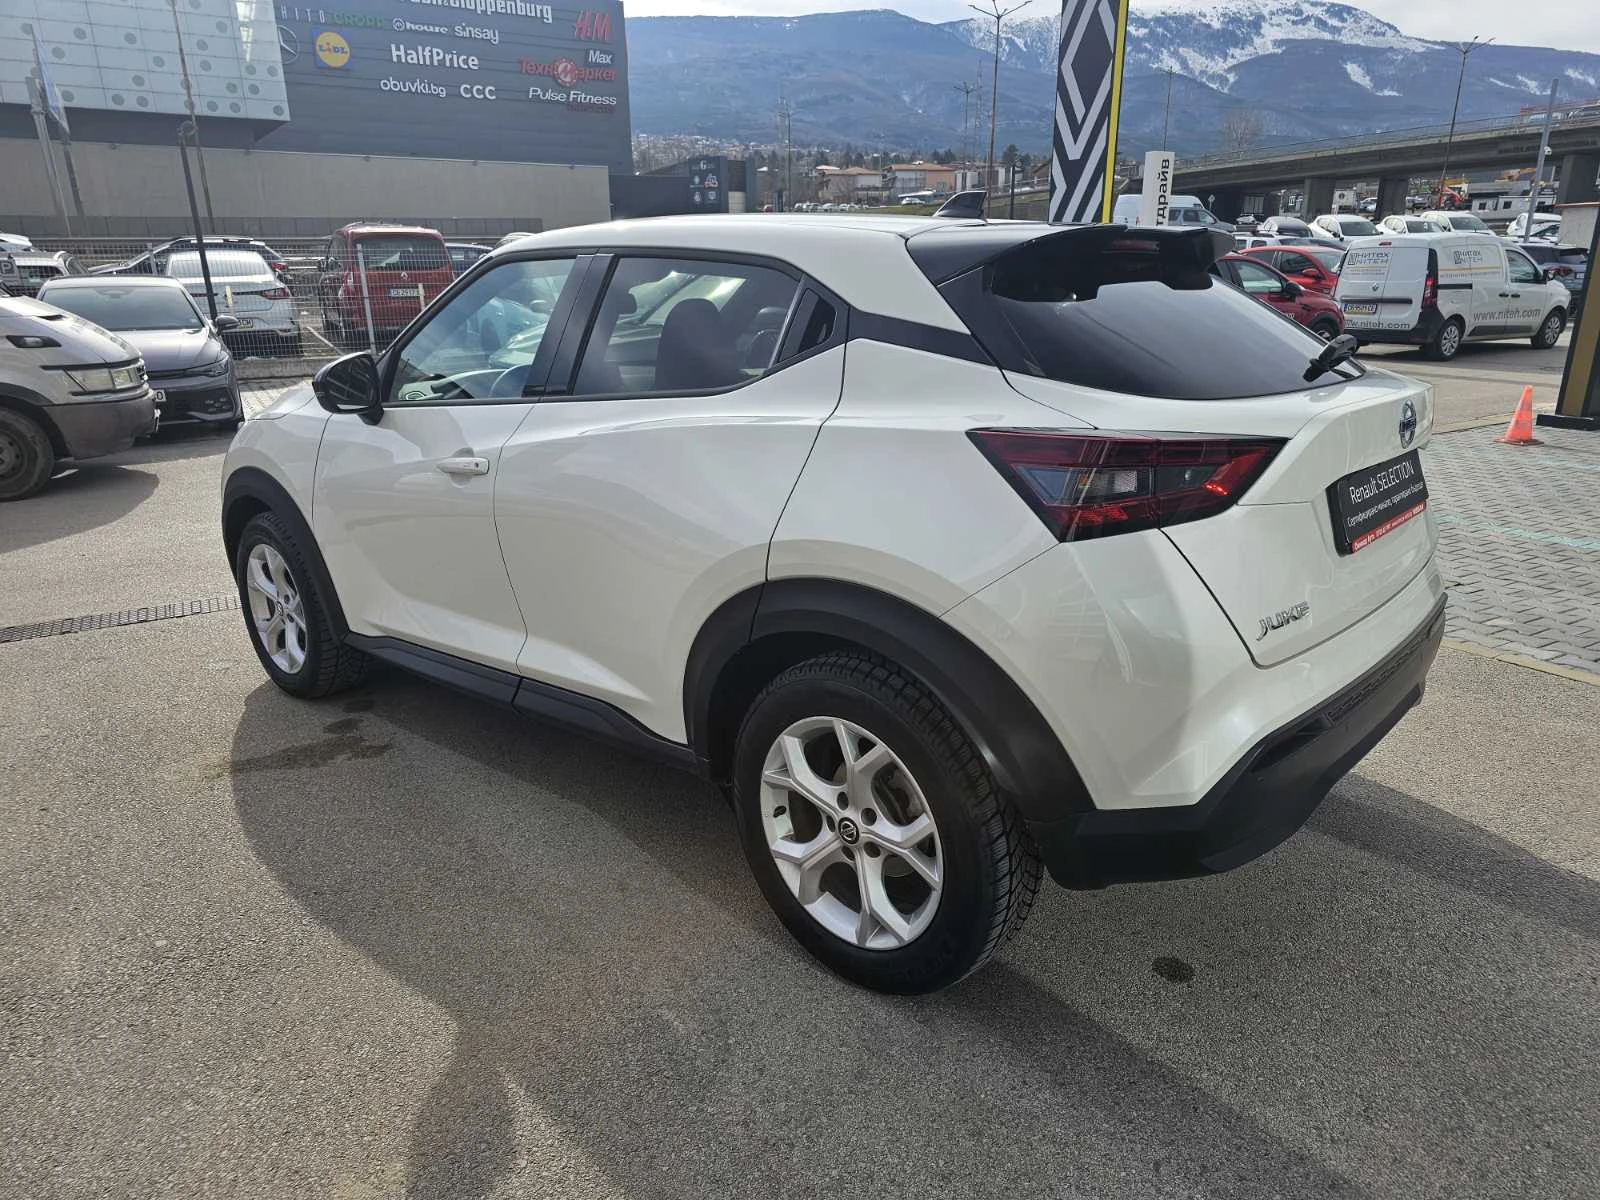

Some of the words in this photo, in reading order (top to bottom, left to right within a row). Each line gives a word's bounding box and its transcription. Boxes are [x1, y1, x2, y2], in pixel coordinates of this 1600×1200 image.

[455, 23, 499, 44] sinsay
[575, 10, 611, 41] H&M
[390, 44, 480, 70] HalfPrice
[588, 50, 612, 65] Max
[380, 77, 447, 97] obuvki.bg
[460, 84, 497, 100] CCC
[528, 87, 567, 102] Pulse
[569, 91, 617, 105] Fitness
[1474, 308, 1540, 321] www.niteh.com
[1349, 477, 1379, 505] Renault
[1377, 460, 1415, 491] SELECTION
[1256, 601, 1311, 642] JUKE
